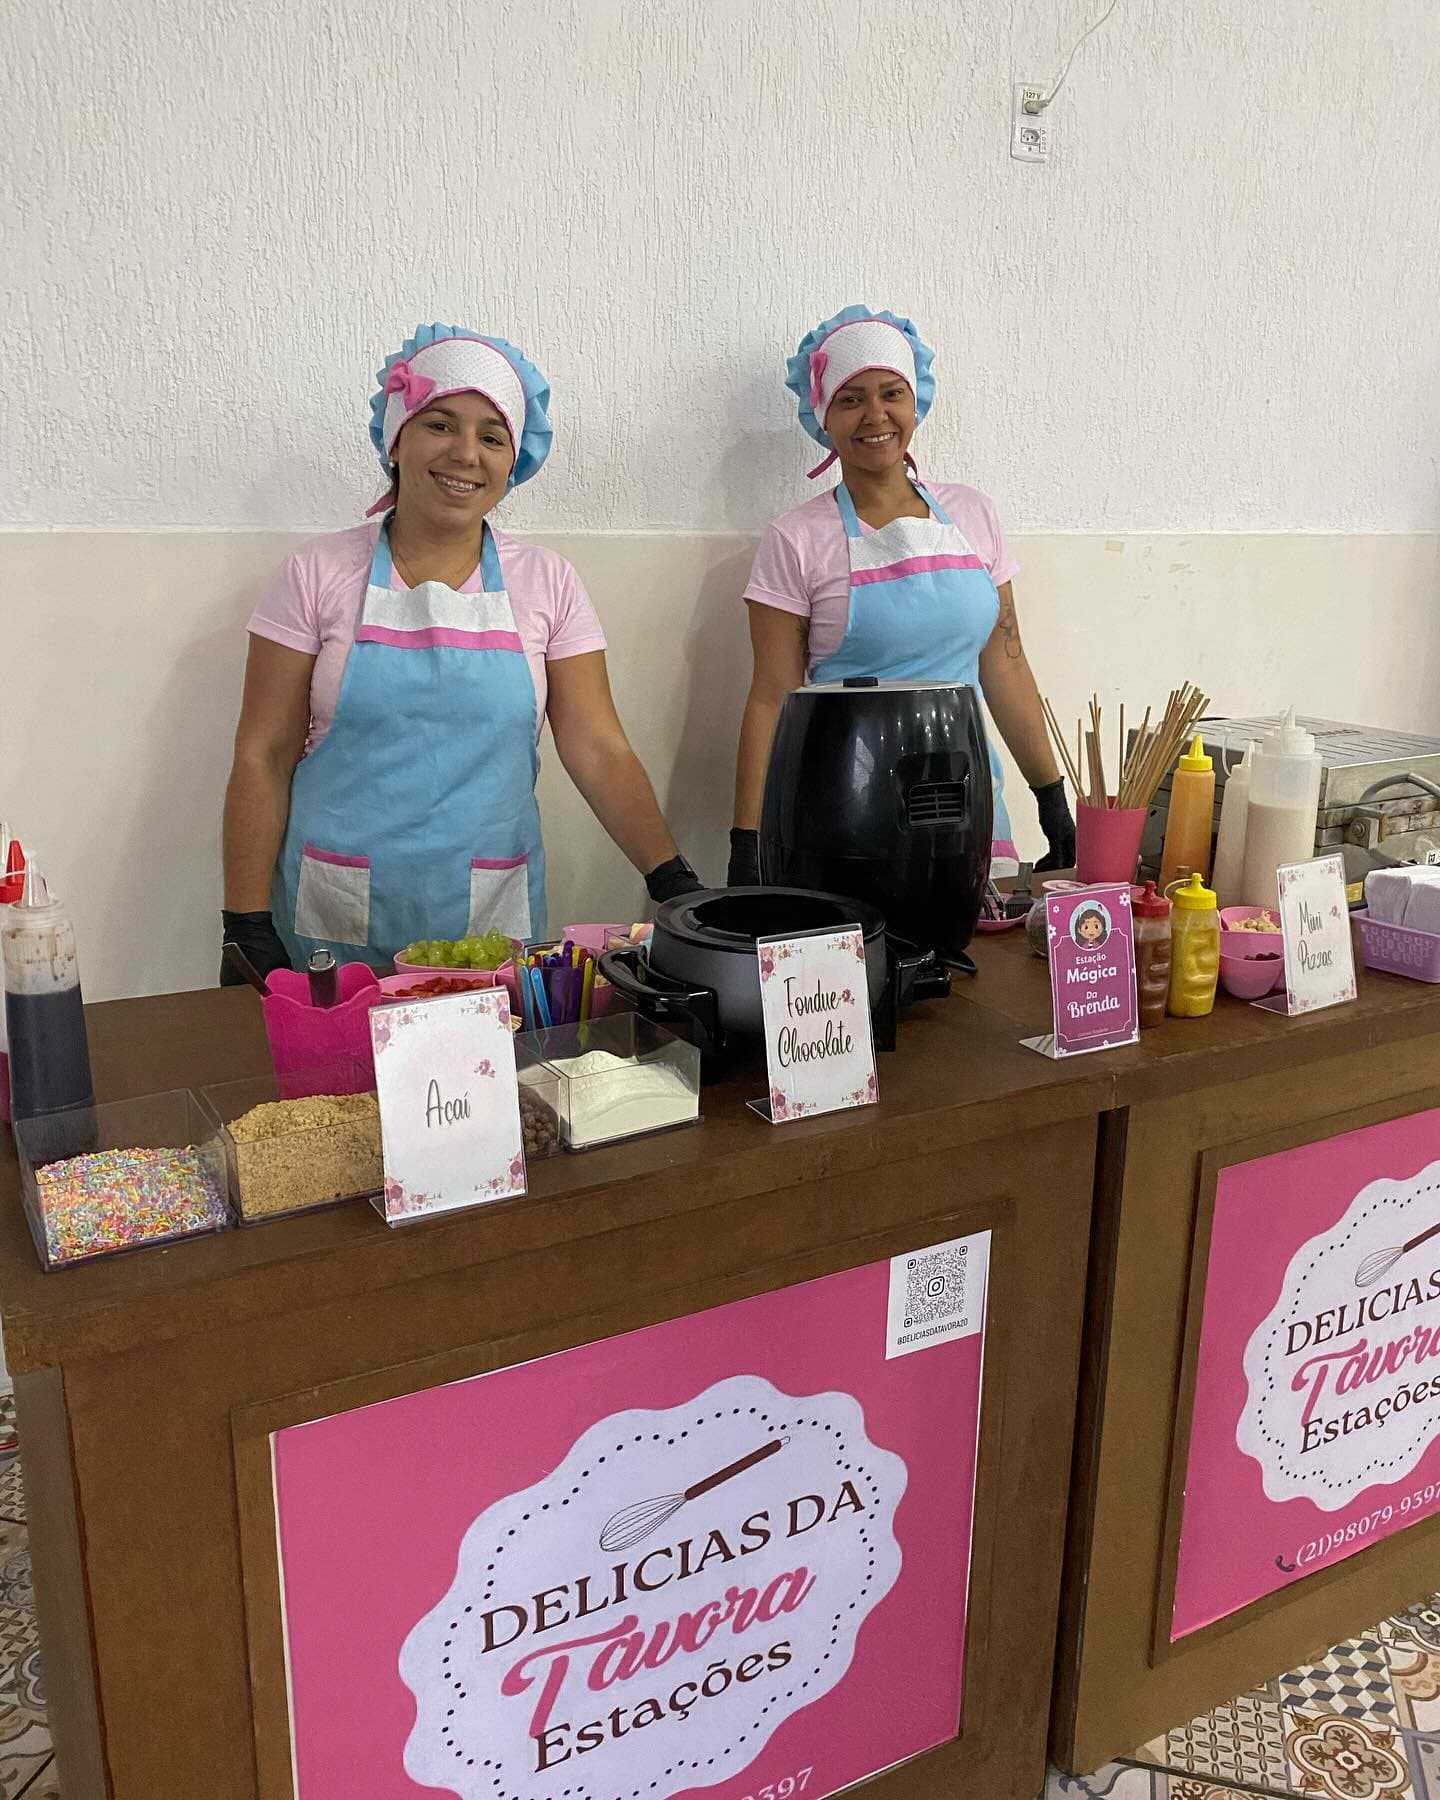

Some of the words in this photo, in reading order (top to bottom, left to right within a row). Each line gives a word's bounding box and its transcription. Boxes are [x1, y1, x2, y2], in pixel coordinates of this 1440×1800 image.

[1299, 901, 1323, 936] Mini
[1066, 965, 1117, 984] Mágica
[1075, 953, 1107, 966] Estação
[1297, 939, 1333, 975] Pizzas
[784, 976, 841, 1018] Fondue
[1067, 995, 1120, 1019] Brenda
[778, 1019, 854, 1068] Chocolate
[425, 1079, 471, 1128] Açaí
[1285, 1269, 1440, 1356] DELICIAS
[1300, 1375, 1440, 1454] Estações
[479, 1510, 771, 1654] DELICIAS
[785, 1480, 866, 1538] DA
[500, 1566, 817, 1738] Tavora
[534, 1640, 793, 1773] Estações
